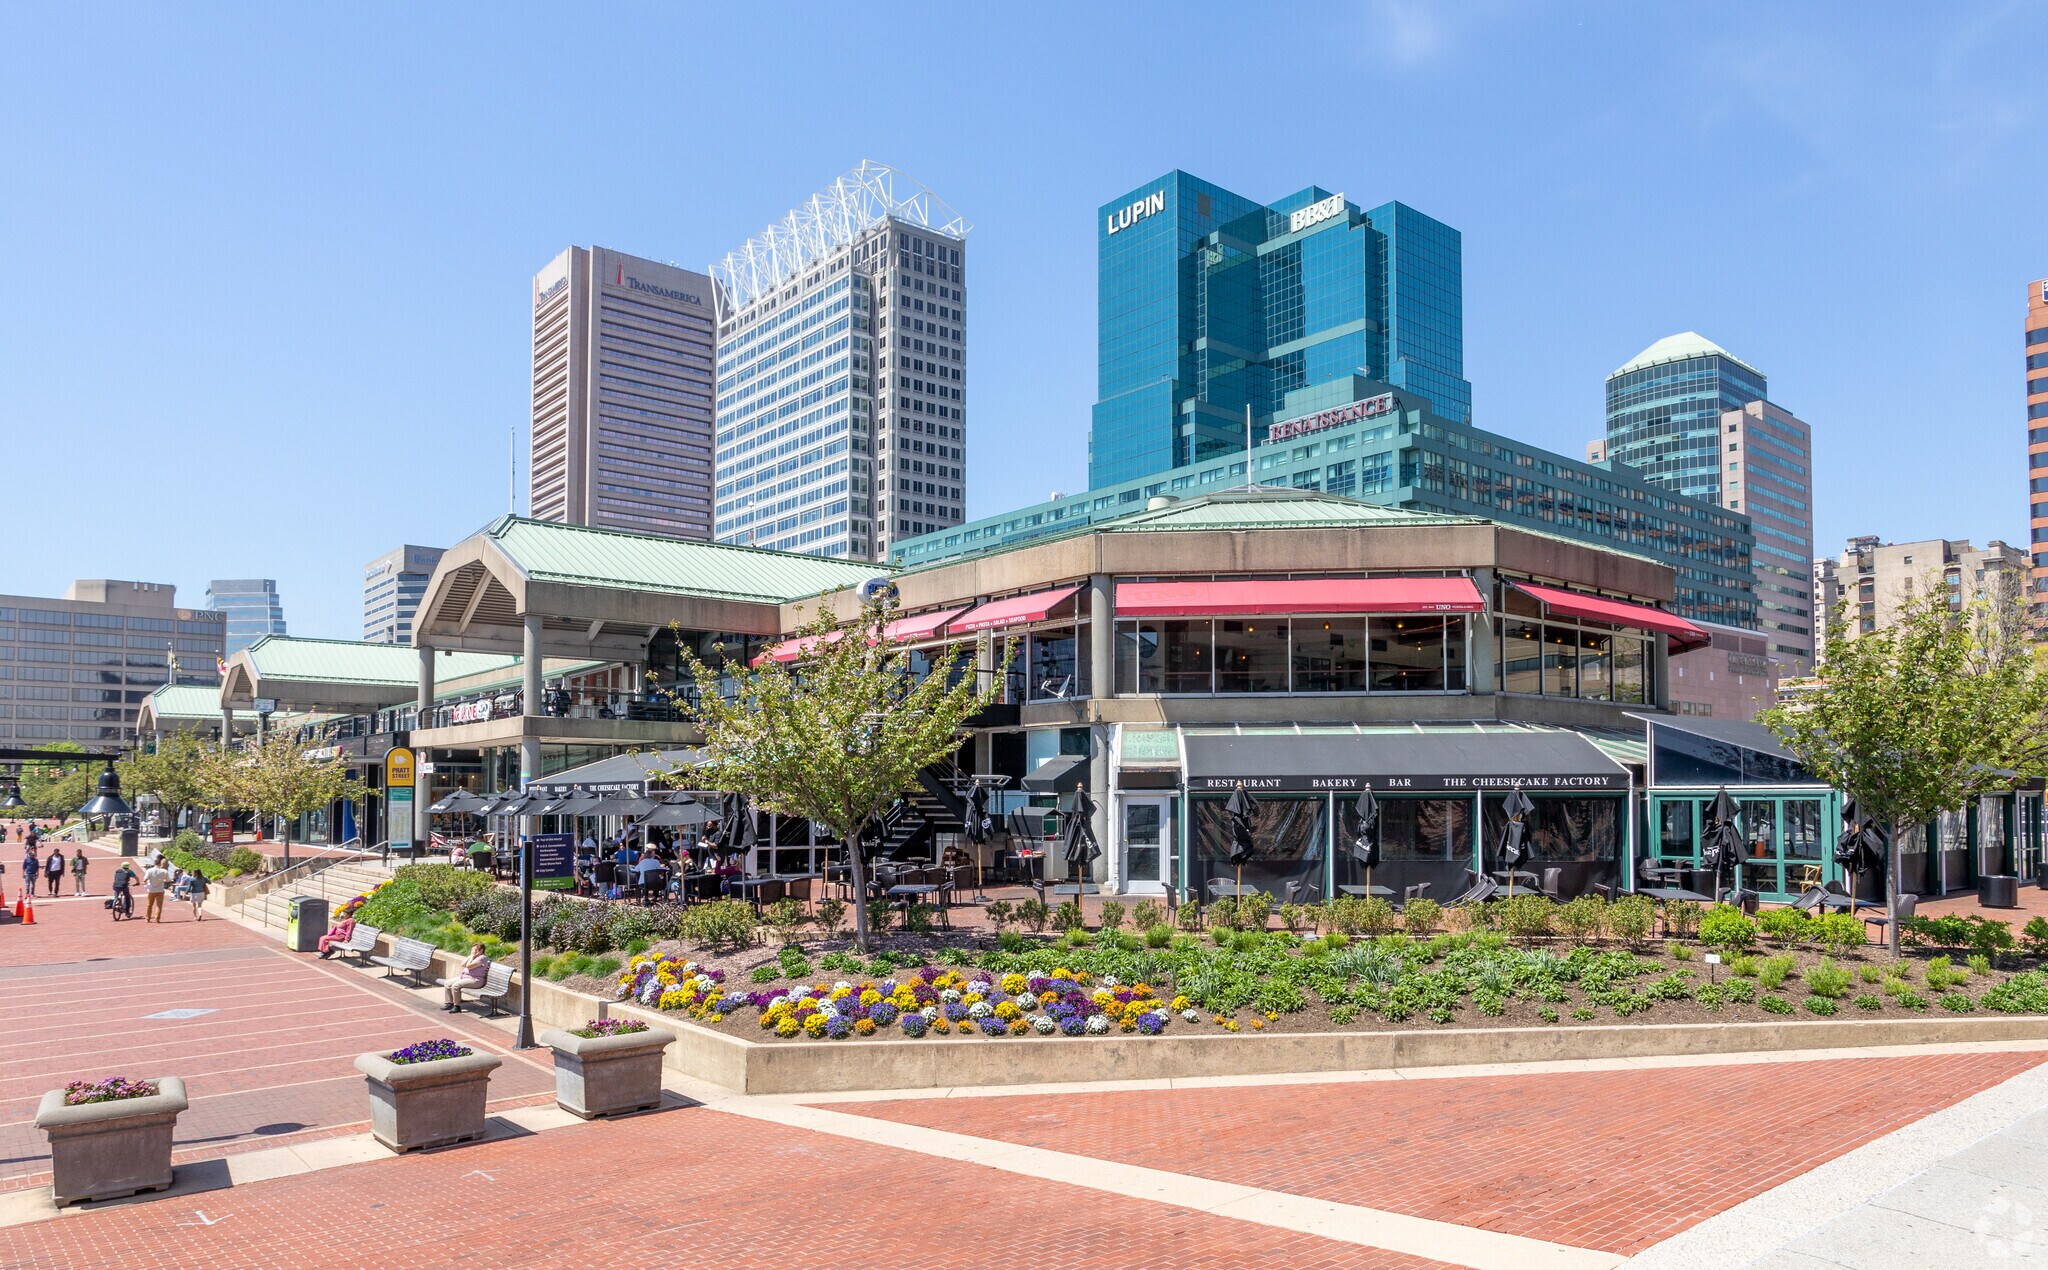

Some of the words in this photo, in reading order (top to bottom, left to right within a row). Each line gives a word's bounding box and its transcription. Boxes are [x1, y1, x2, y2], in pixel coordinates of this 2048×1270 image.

[1108, 190, 1165, 235] LUPIN
[1291, 193, 1345, 233] BB&T
[627, 276, 702, 306] TRANSAMERICA
[195, 610, 224, 622] PNC
[1008, 615, 1027, 623] SEAFOOD
[1312, 779, 1357, 788] BAKERY
[1389, 778, 1412, 787] BAR
[1443, 778, 1467, 787] THE
[1472, 777, 1549, 786] CHEESECAKE
[1554, 777, 1609, 786] FACTORY
